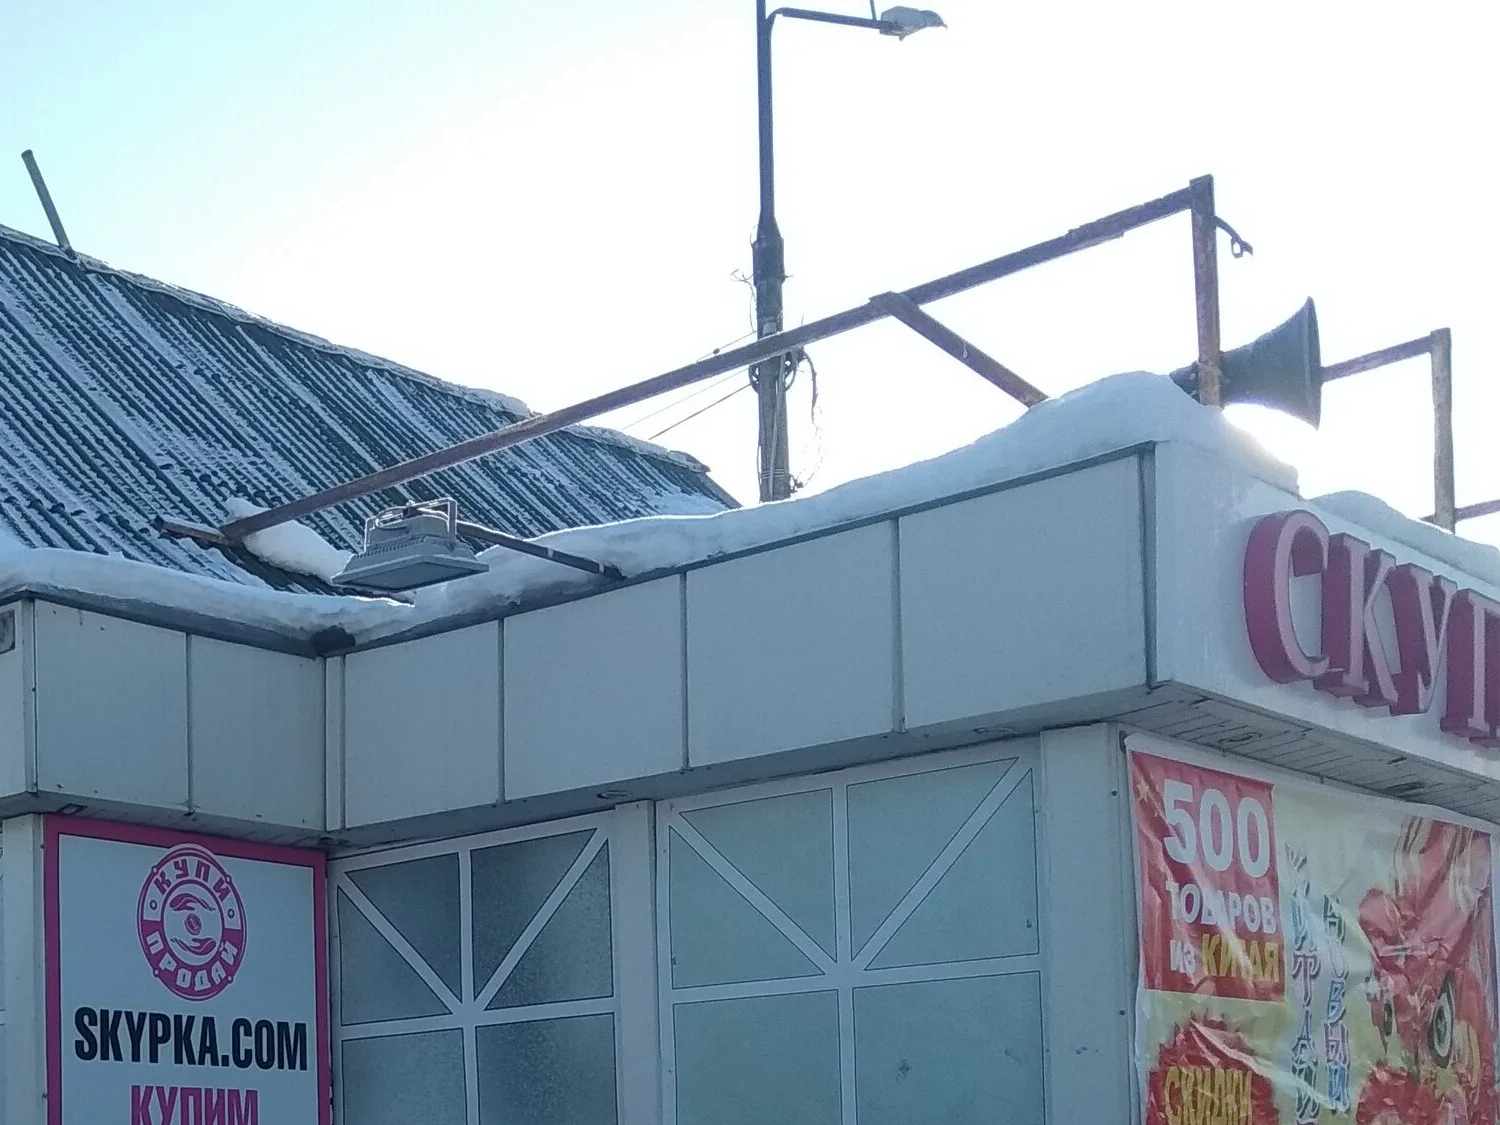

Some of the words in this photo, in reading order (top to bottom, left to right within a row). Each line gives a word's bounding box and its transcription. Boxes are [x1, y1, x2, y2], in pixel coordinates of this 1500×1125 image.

[1164, 778, 1270, 878] 500
[154, 858, 231, 902] КУПИ
[1165, 880, 1277, 935] ТОВАРОВ
[146, 931, 238, 991] ПРОДАЙ
[1199, 932, 1280, 983] КИТАЯ
[74, 1006, 308, 1072] SKYPKA.COM
